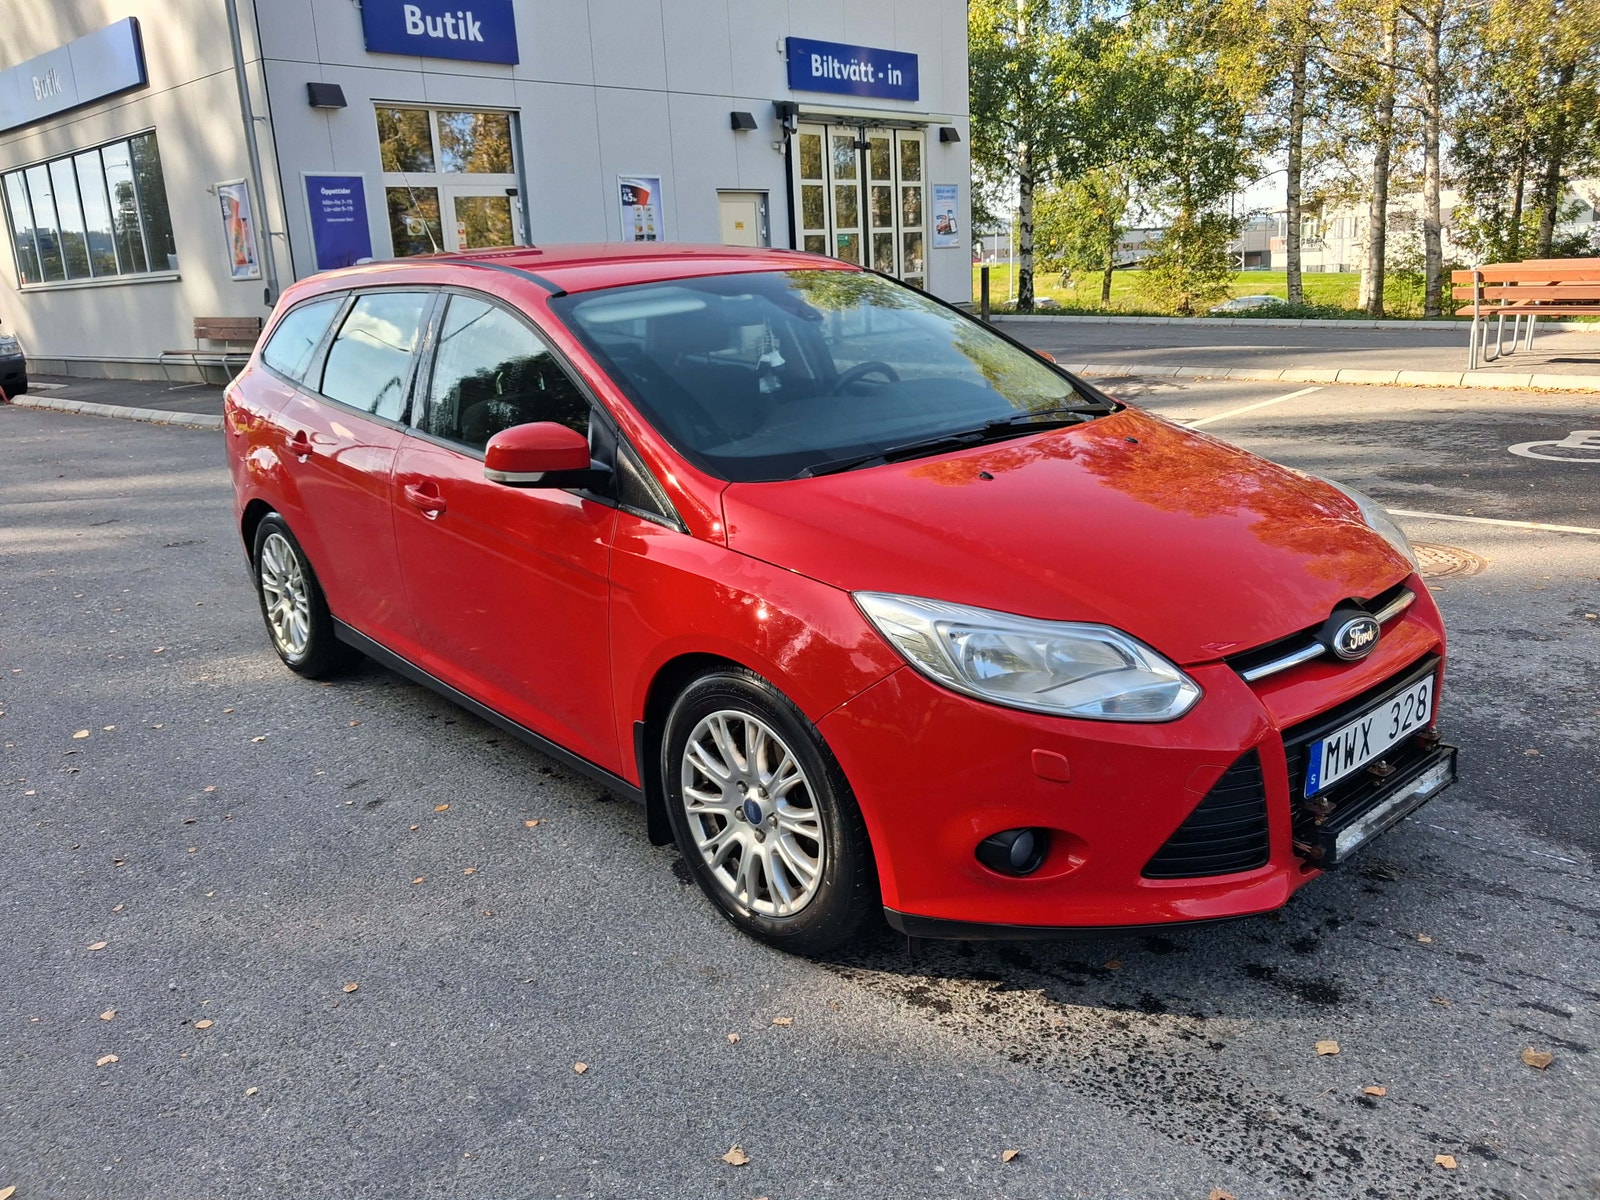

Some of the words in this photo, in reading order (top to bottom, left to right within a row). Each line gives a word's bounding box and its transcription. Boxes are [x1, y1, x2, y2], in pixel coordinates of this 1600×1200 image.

[404, 4, 484, 43] Butik
[32, 67, 63, 101] Butik
[811, 53, 875, 83] Biltvätt
[887, 63, 902, 85] in
[320, 187, 351, 196] Öppettider
[1349, 623, 1375, 649] Ford
[1324, 717, 1373, 781] MWX
[1389, 684, 1427, 740] 328
[1310, 774, 1317, 785] S
